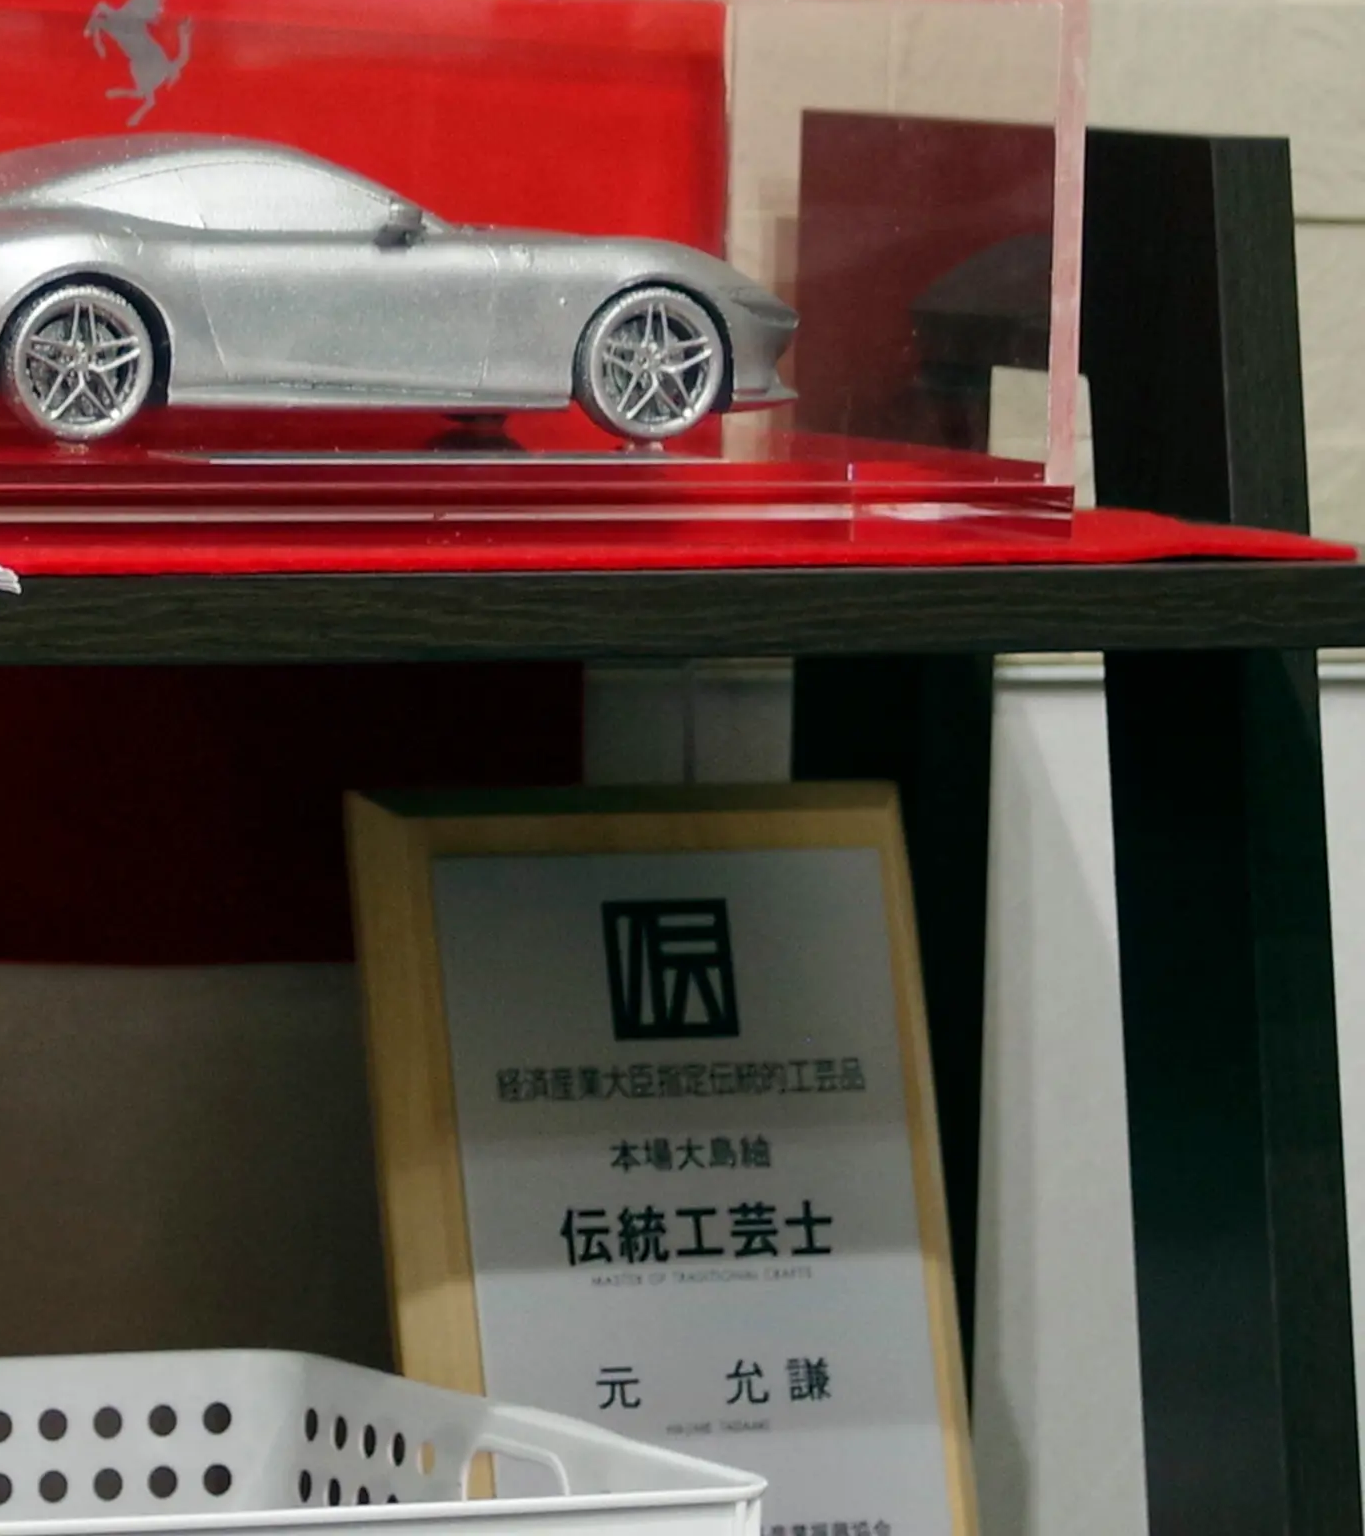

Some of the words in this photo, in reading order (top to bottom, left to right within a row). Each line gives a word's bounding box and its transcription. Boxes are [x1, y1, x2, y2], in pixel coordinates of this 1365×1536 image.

[560, 1200, 834, 1267] 伝統工芸士
[595, 1366, 642, 1410] 元
